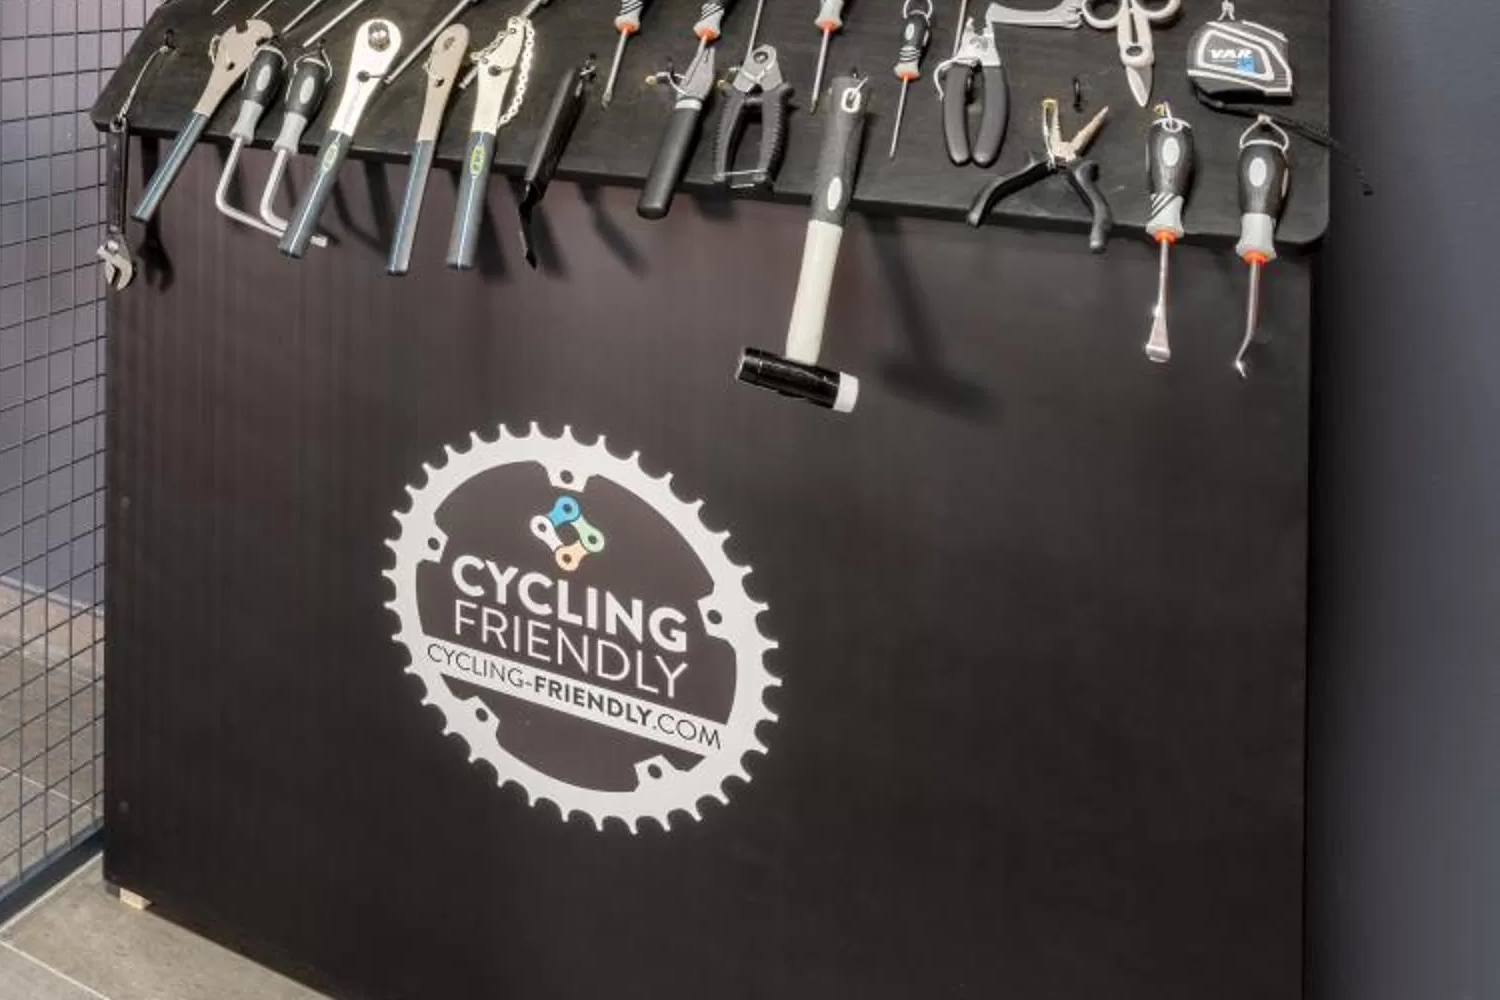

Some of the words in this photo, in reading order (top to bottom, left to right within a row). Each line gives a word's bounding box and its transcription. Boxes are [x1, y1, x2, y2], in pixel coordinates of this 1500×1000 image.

[451, 554, 688, 653] CYCLING
[454, 599, 689, 699] FRIENDLY
[426, 643, 722, 750] CYCLING-FRIENDLY.COM
